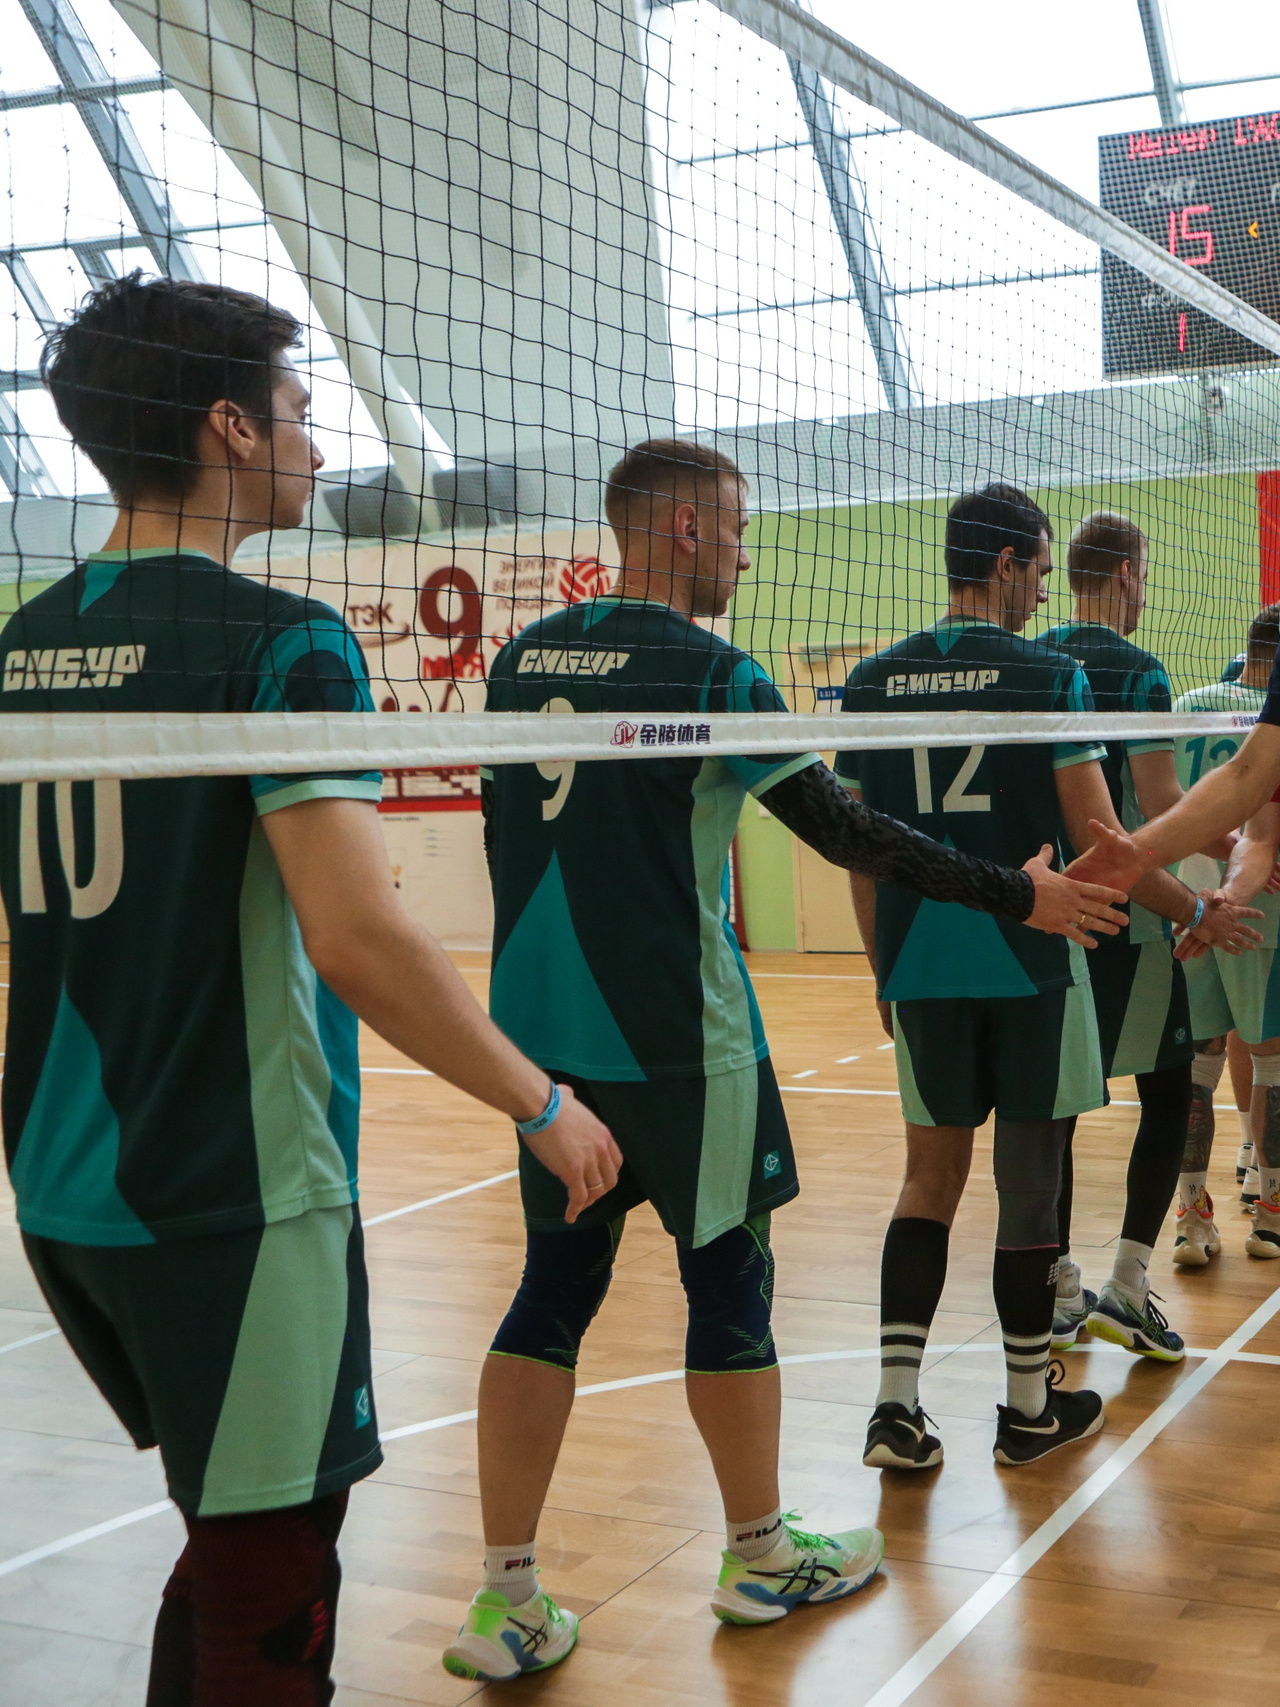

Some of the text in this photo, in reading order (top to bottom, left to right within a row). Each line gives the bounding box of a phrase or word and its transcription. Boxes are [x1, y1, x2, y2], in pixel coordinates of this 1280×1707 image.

[1168, 204, 1214, 266] 15
[1178, 312, 1186, 353] 1
[348, 602, 393, 626] ТЭК
[420, 566, 481, 656] 9
[3, 645, 146, 692] СИБУР
[517, 649, 630, 676] СИБУР
[886, 669, 1000, 697] СИБУР
[912, 745, 991, 814] 12
[19, 779, 124, 920] 10
